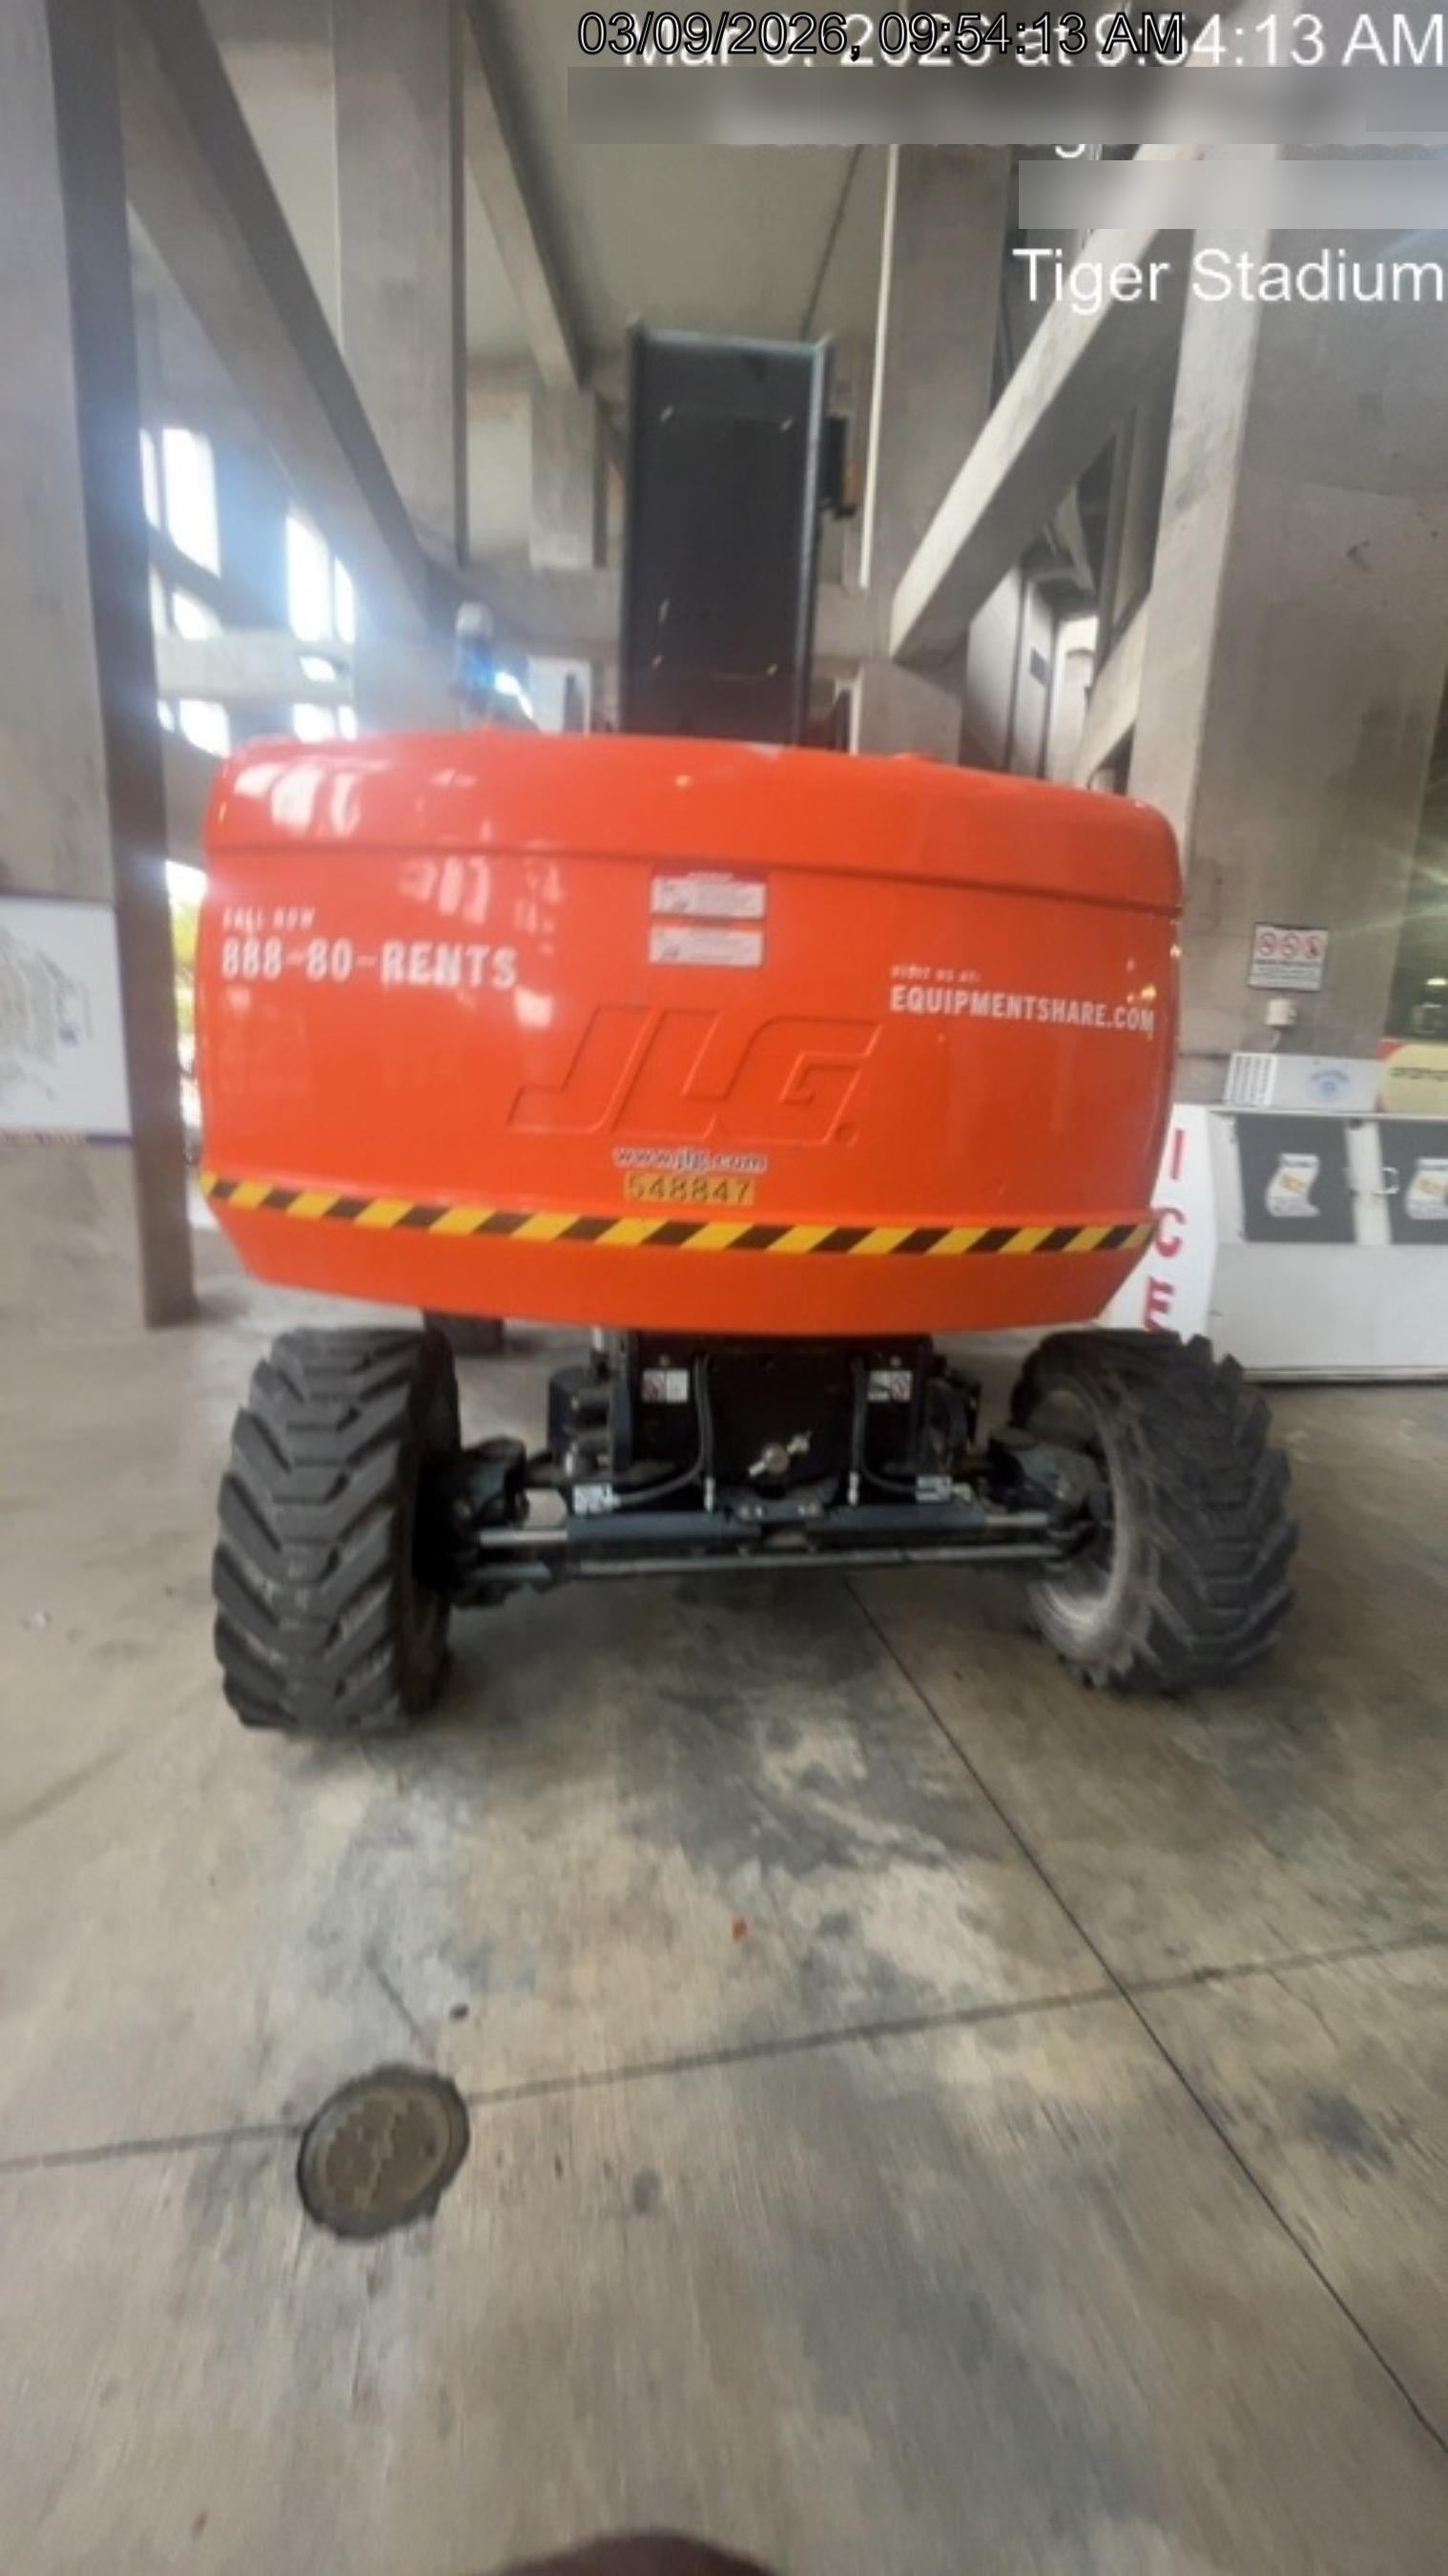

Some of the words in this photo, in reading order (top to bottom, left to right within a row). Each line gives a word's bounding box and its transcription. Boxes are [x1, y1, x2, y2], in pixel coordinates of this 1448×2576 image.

[222, 937, 518, 989] 888-80-RENTS
[889, 984, 1155, 1032] EQUIPMENTSHARE.COM
[506, 1004, 884, 1146] JLG
[627, 1173, 753, 1204] 548847
